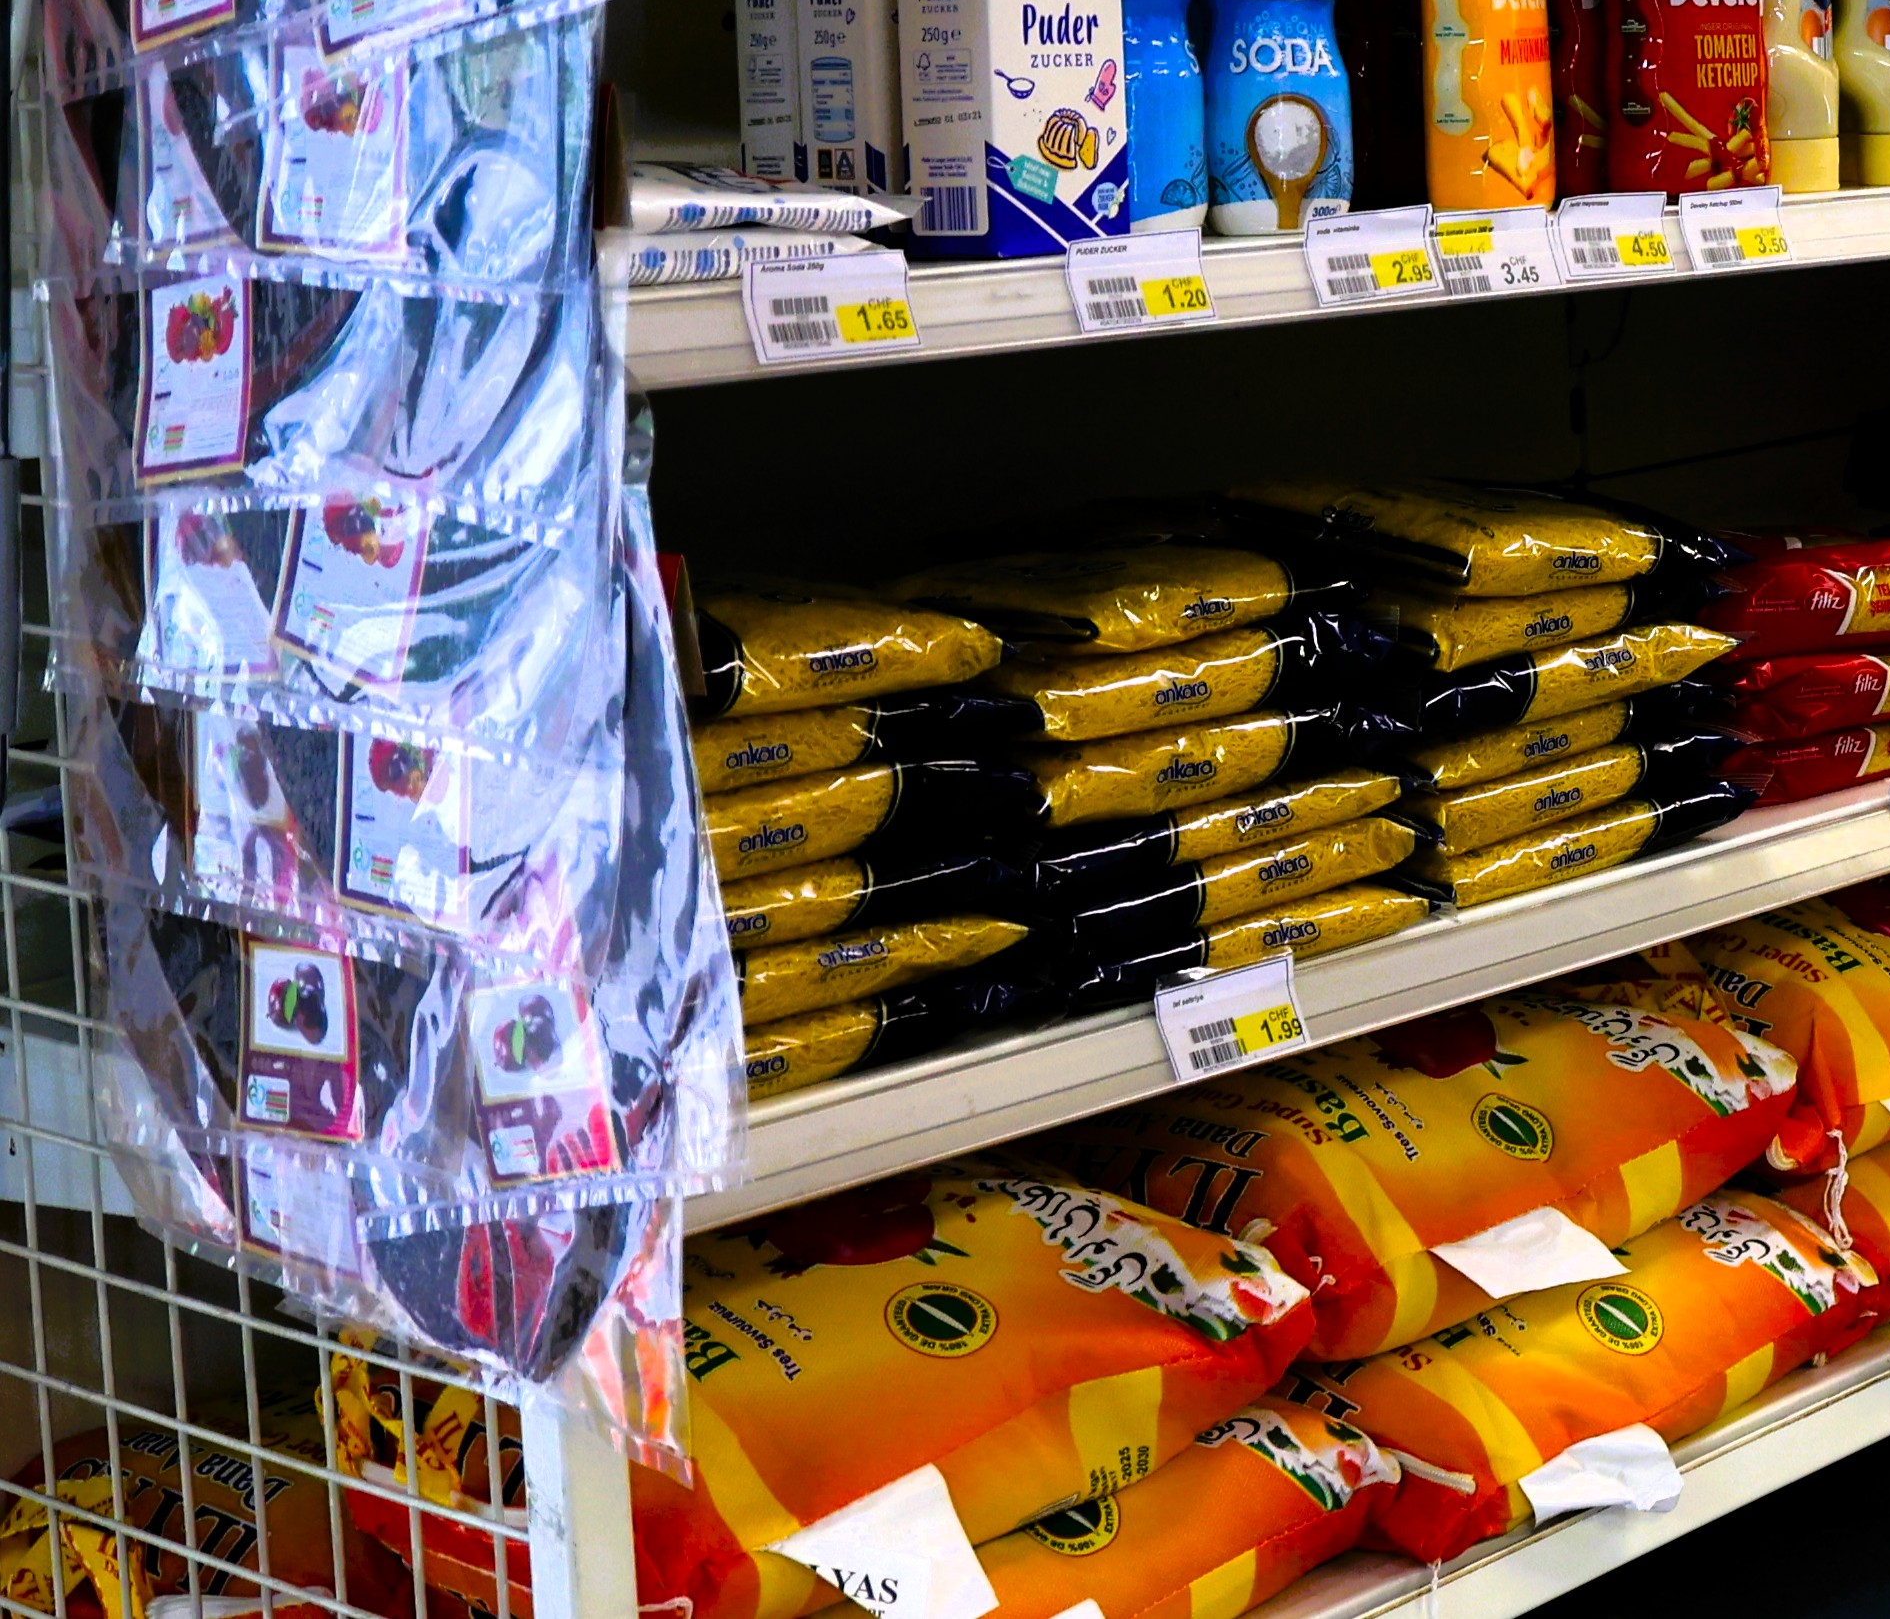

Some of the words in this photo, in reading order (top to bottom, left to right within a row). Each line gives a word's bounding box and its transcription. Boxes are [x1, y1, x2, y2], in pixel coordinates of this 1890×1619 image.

[1022, 2, 1099, 46] Puder
[1230, 36, 1335, 75] SODA
[1694, 33, 1757, 61] TOMATEN
[1030, 53, 1095, 69] ZUCKER
[1697, 62, 1759, 90] KETCHUP
[1075, 246, 1099, 257] PUDER
[1100, 244, 1128, 255] ZUCKER
[1632, 237, 1668, 257] 4.50
[1755, 233, 1788, 255] 3.50
[760, 263, 786, 274] Aroma
[1392, 260, 1433, 283] 2.95
[1401, 253, 1419, 265] CHF
[1509, 256, 1526, 266] CHF
[1172, 277, 1193, 290] CHF
[1501, 263, 1540, 285] 3.45
[1162, 283, 1208, 310] 1.20
[856, 305, 908, 333] 1.65
[1553, 551, 1599, 572] ankara
[1810, 589, 1846, 612] filiz
[1524, 613, 1571, 638] ankara
[810, 648, 874, 674] ankara
[1155, 681, 1209, 706] ankara
[1855, 674, 1883, 695] filiz
[726, 742, 789, 770] ankara
[1524, 733, 1570, 758] ankara
[1835, 735, 1866, 757] filiz
[1157, 757, 1214, 785] ankara
[1534, 787, 1581, 812] ankara
[739, 822, 805, 854] ankara
[1258, 852, 1310, 883] ankara
[1550, 843, 1597, 872] ankara
[1263, 919, 1318, 948] ankara
[818, 939, 886, 969] ankara
[1755, 944, 1829, 984] Super
[1268, 1008, 1290, 1022] CHF
[1261, 1017, 1304, 1043] 1.99
[1167, 1114, 1269, 1159] Dana
[1249, 1098, 1333, 1149] Super
[1389, 1125, 1422, 1161] Tres
[707, 1299, 775, 1352] Savoureux
[774, 1349, 803, 1382] Tres
